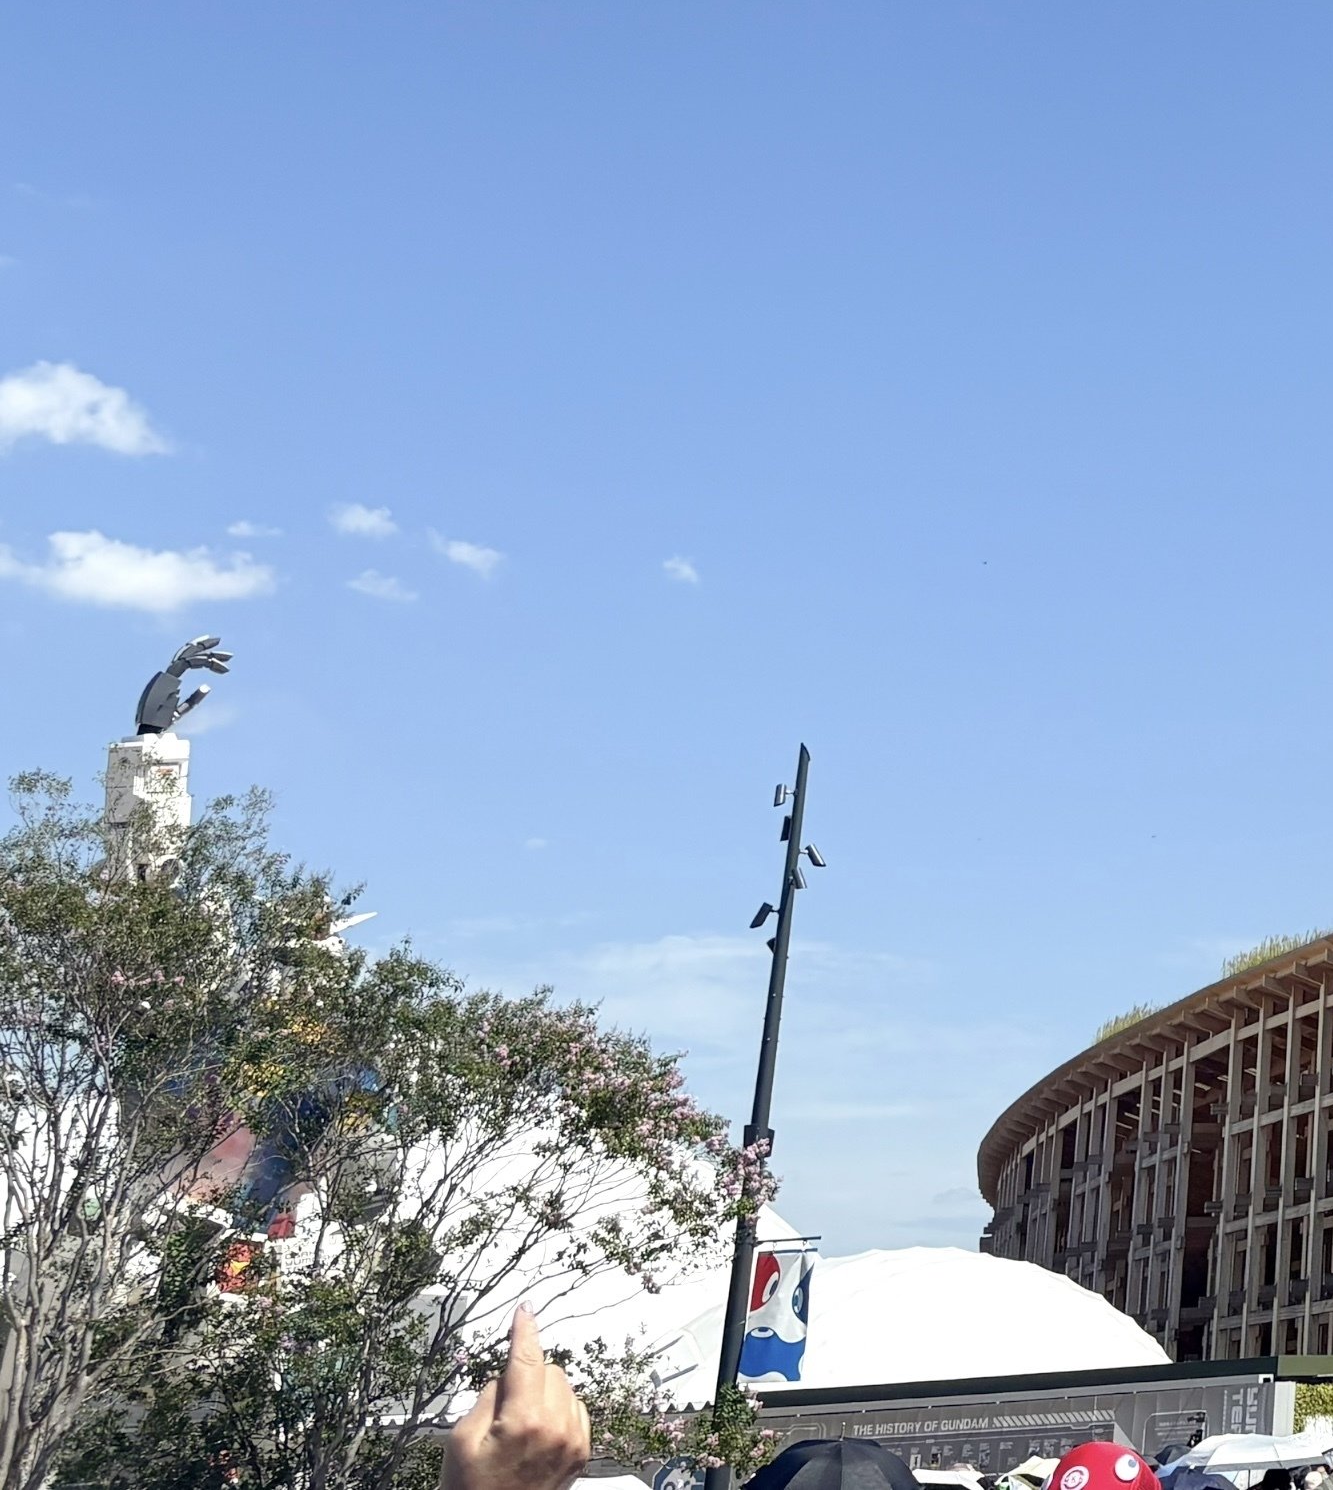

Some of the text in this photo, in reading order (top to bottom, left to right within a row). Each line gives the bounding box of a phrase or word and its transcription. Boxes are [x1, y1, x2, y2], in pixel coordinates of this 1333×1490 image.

[853, 1417, 989, 1436] THE HISTORY OF GUNDAM
